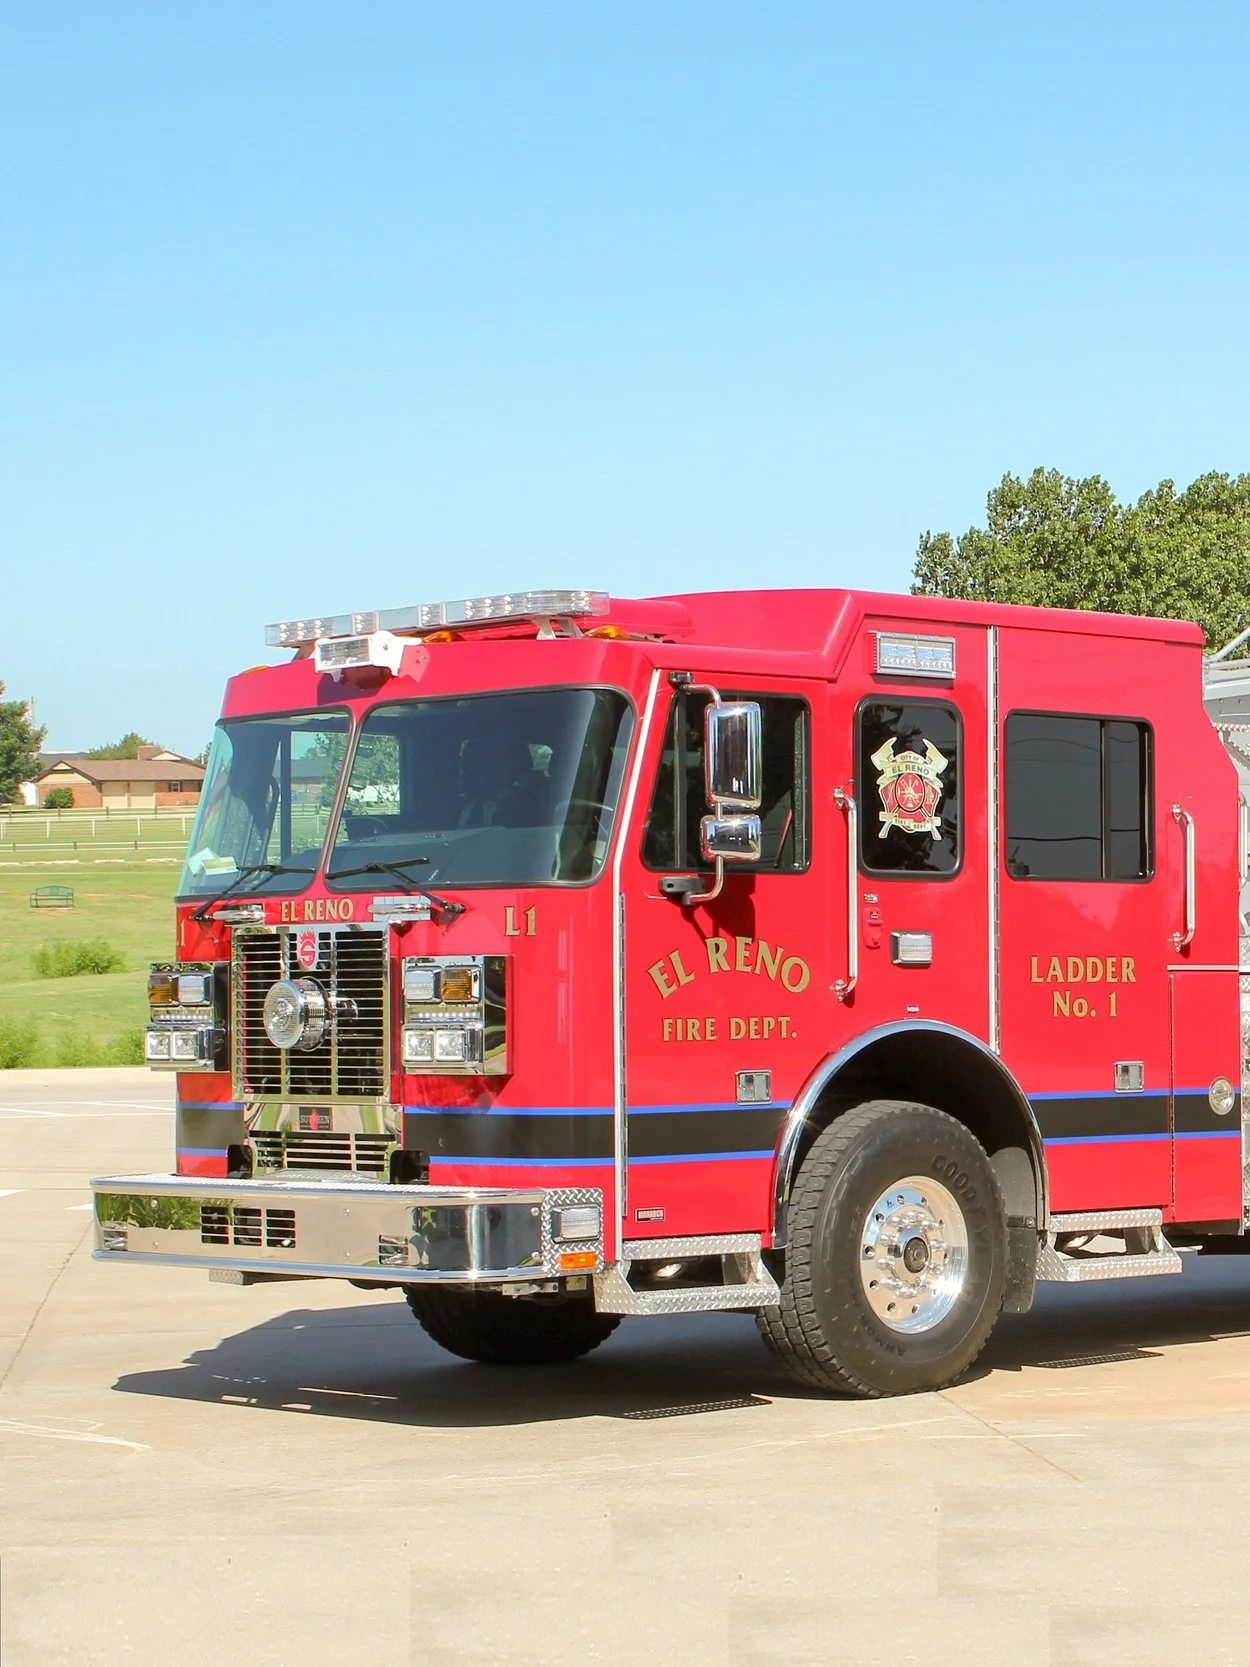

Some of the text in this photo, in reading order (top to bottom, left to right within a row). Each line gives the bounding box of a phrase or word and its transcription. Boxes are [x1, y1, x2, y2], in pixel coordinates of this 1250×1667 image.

[891, 764, 930, 776] EL RENO
[281, 898, 354, 923] EL RENO
[504, 904, 537, 937] L1
[648, 935, 811, 1000] EL RENO
[1030, 955, 1137, 984] LADDER
[1052, 989, 1118, 1018] No. 1
[661, 1015, 799, 1042] FIRE DEPT.
